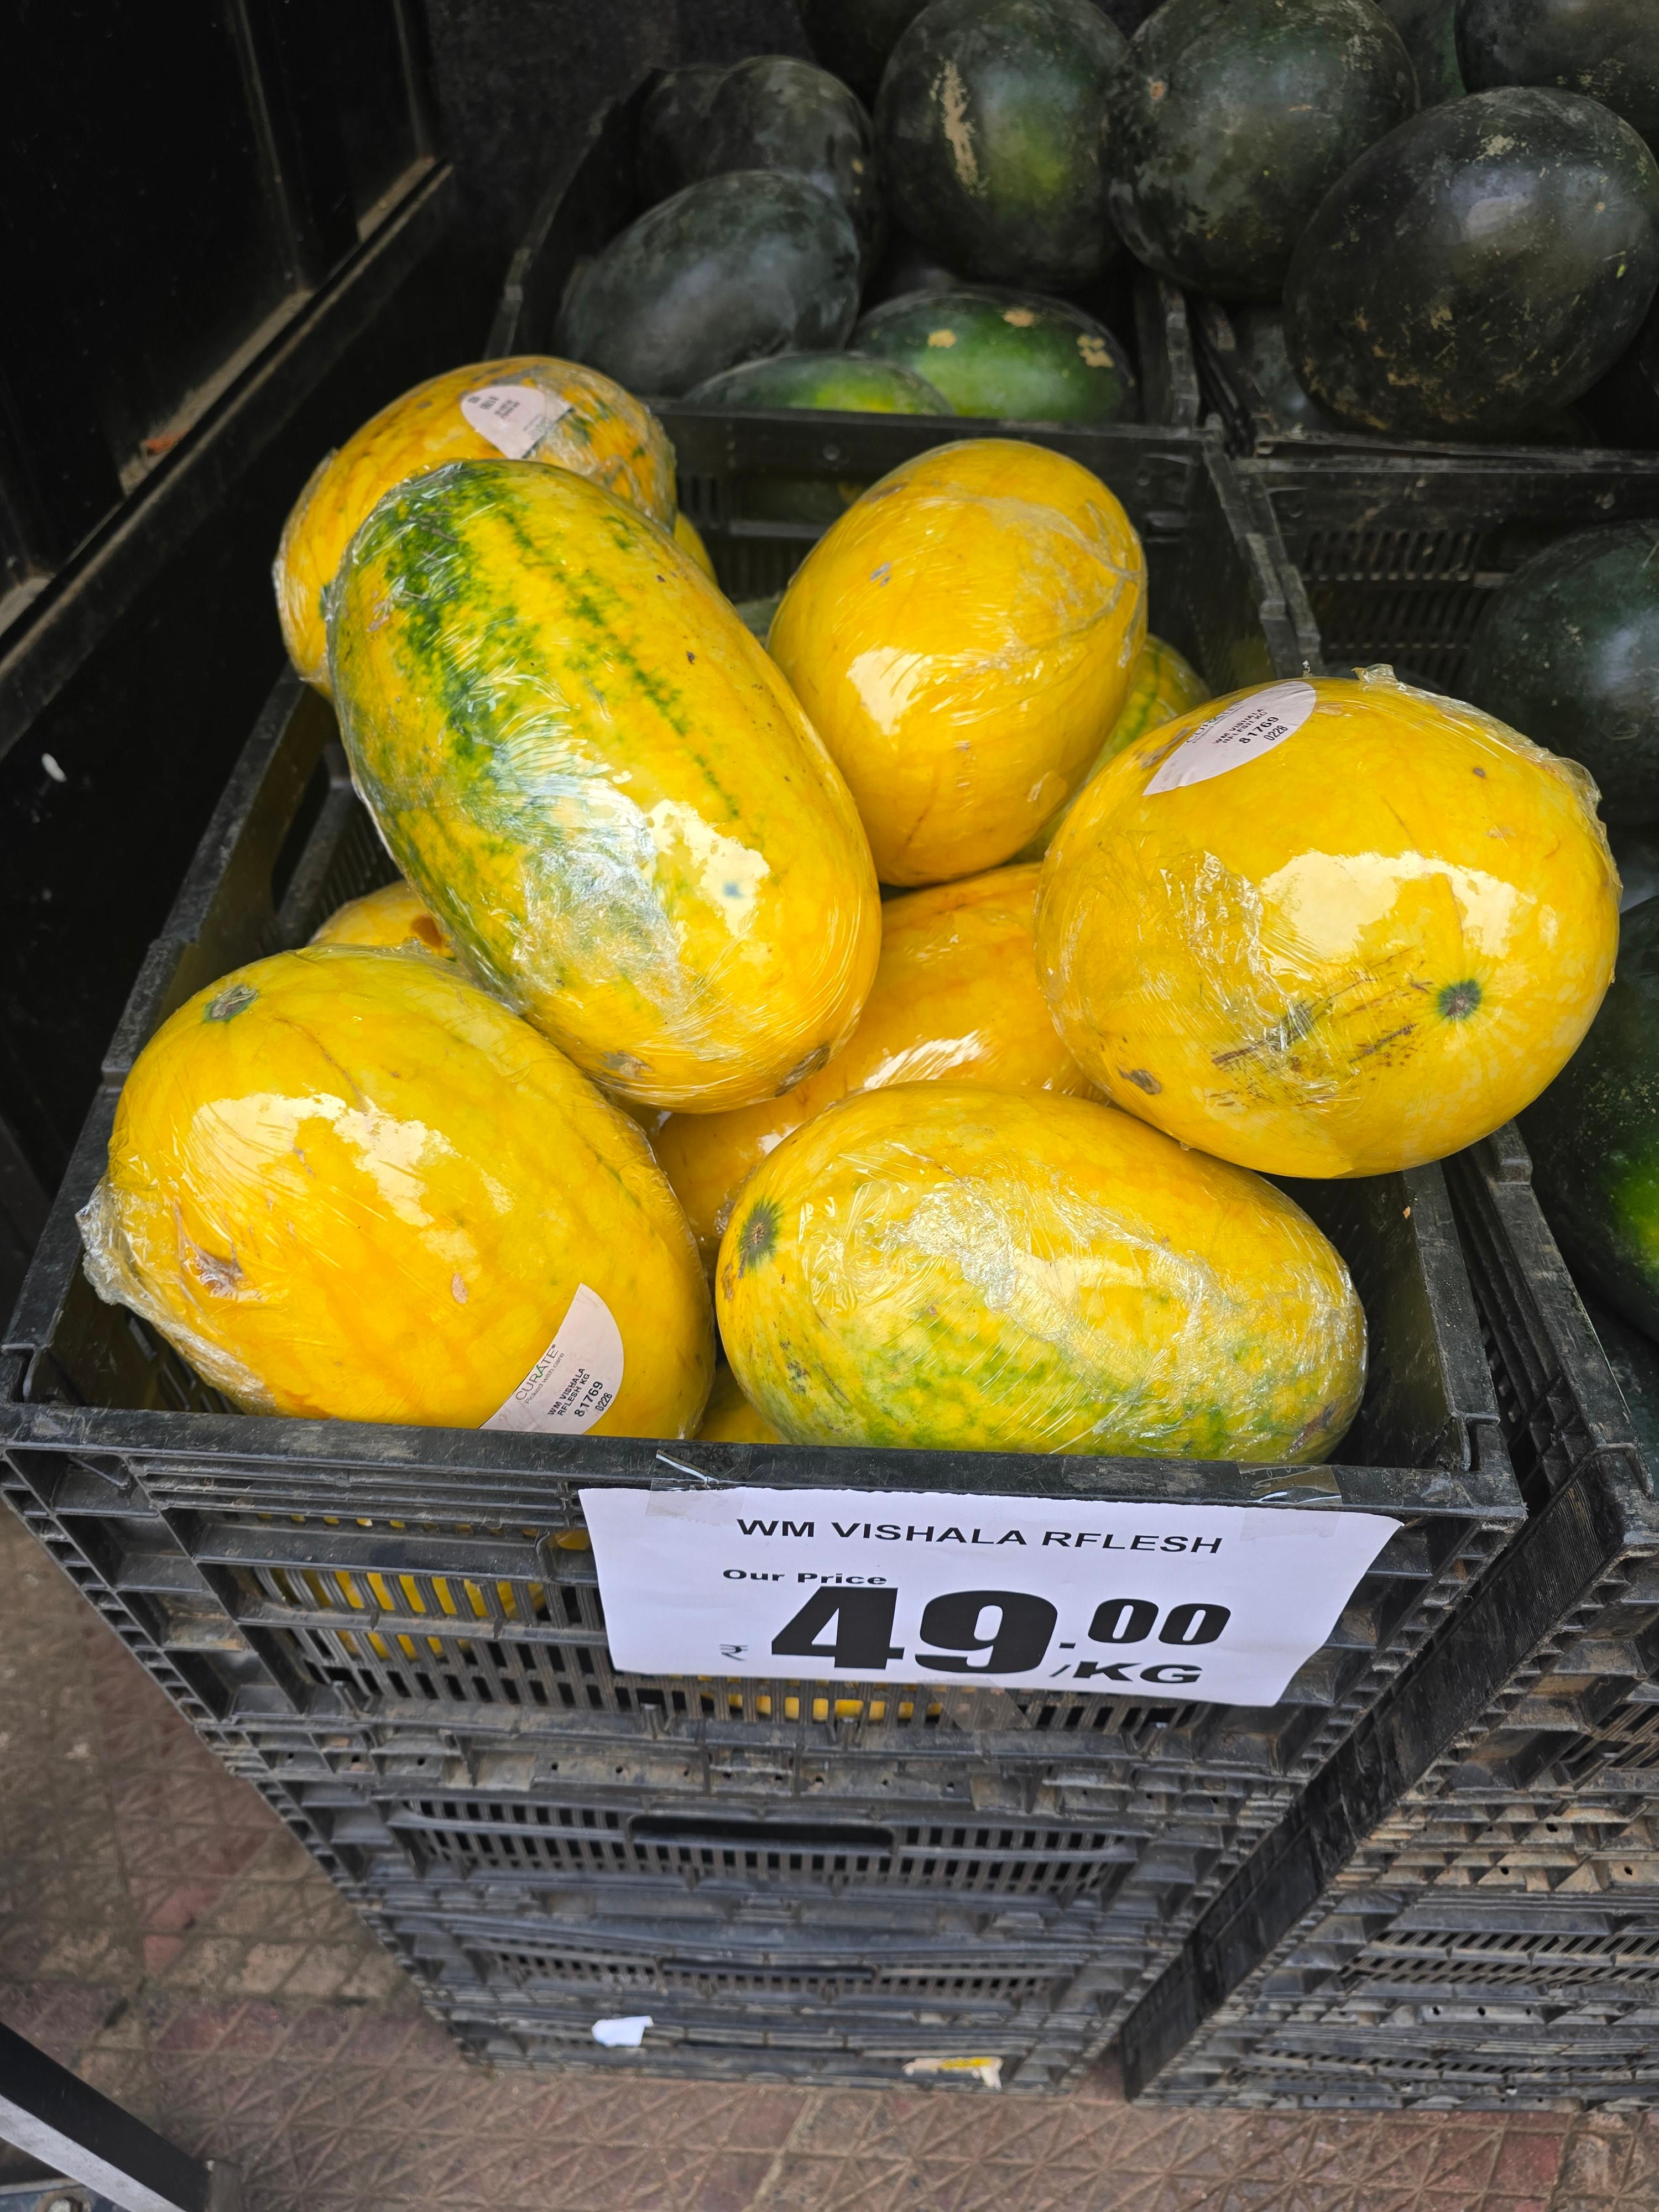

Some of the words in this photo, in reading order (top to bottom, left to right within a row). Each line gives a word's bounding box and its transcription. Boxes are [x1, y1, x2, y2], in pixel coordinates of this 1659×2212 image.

[1212, 733, 1230, 744] WM
[1239, 717, 1279, 744] 81769
[1263, 725, 1289, 741] 0228
[542, 1369, 554, 1383] with
[553, 1353, 565, 1368] care
[547, 1401, 562, 1415] WM
[559, 1368, 585, 1399] VISHALA
[557, 1386, 582, 1416] RFLESH
[580, 1373, 590, 1385] KG
[574, 1381, 603, 1417] 81769
[594, 1392, 613, 1411] 0228
[737, 1519, 815, 1537] WM
[831, 1522, 1027, 1545] VISHALA
[1042, 1531, 1223, 1554] RFLESH
[723, 1569, 785, 1581] Our
[798, 1573, 887, 1585] Price
[1049, 1661, 1203, 1684] /KG
